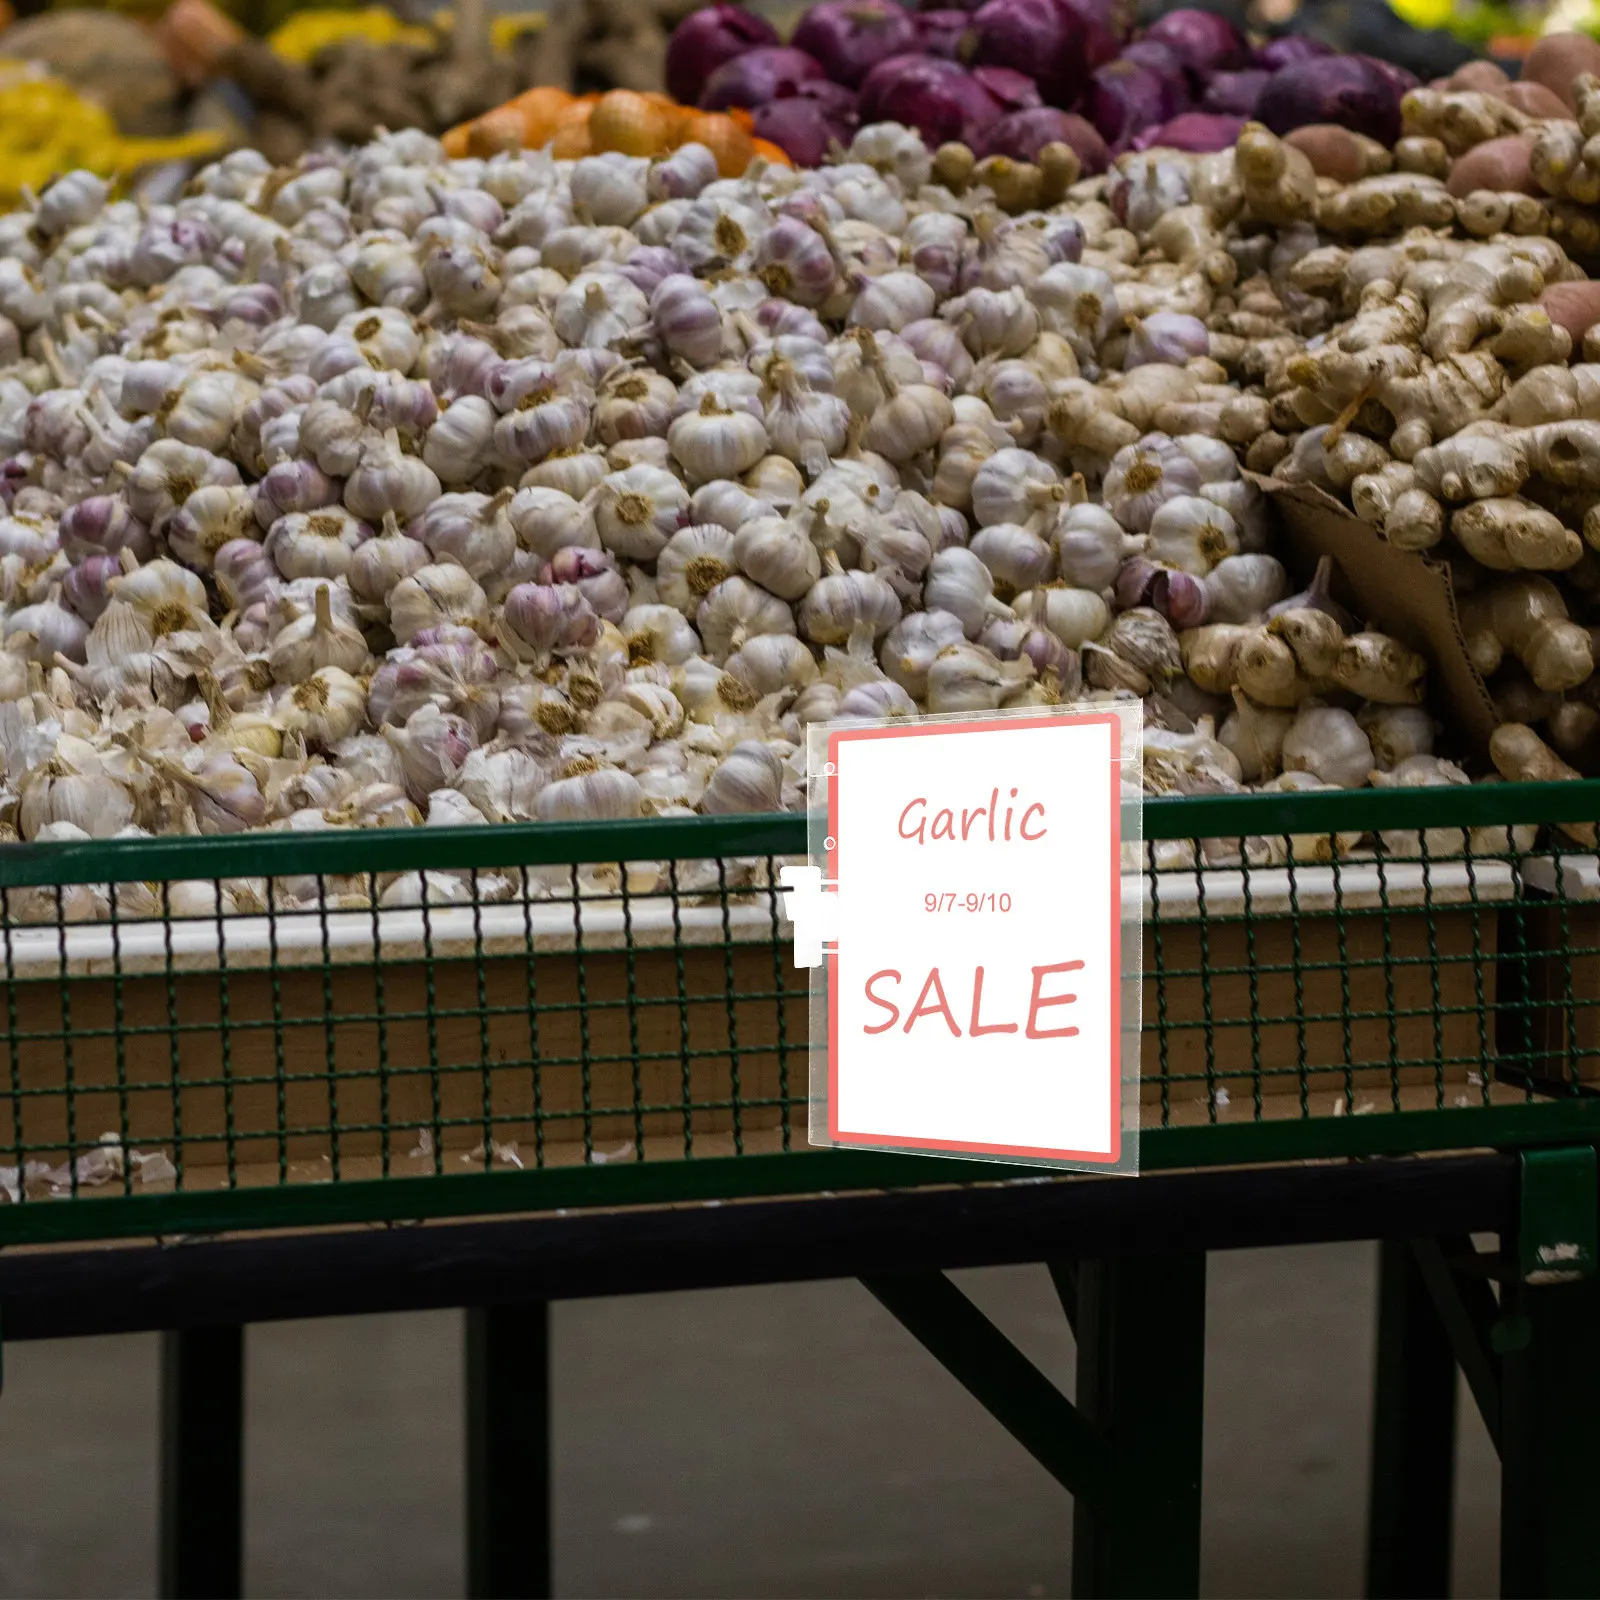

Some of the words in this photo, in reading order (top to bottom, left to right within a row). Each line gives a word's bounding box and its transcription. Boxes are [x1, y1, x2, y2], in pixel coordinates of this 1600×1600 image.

[898, 787, 1048, 845] Garlic
[924, 892, 1012, 912] 9/7-9/10
[863, 959, 1085, 1040] SALE
